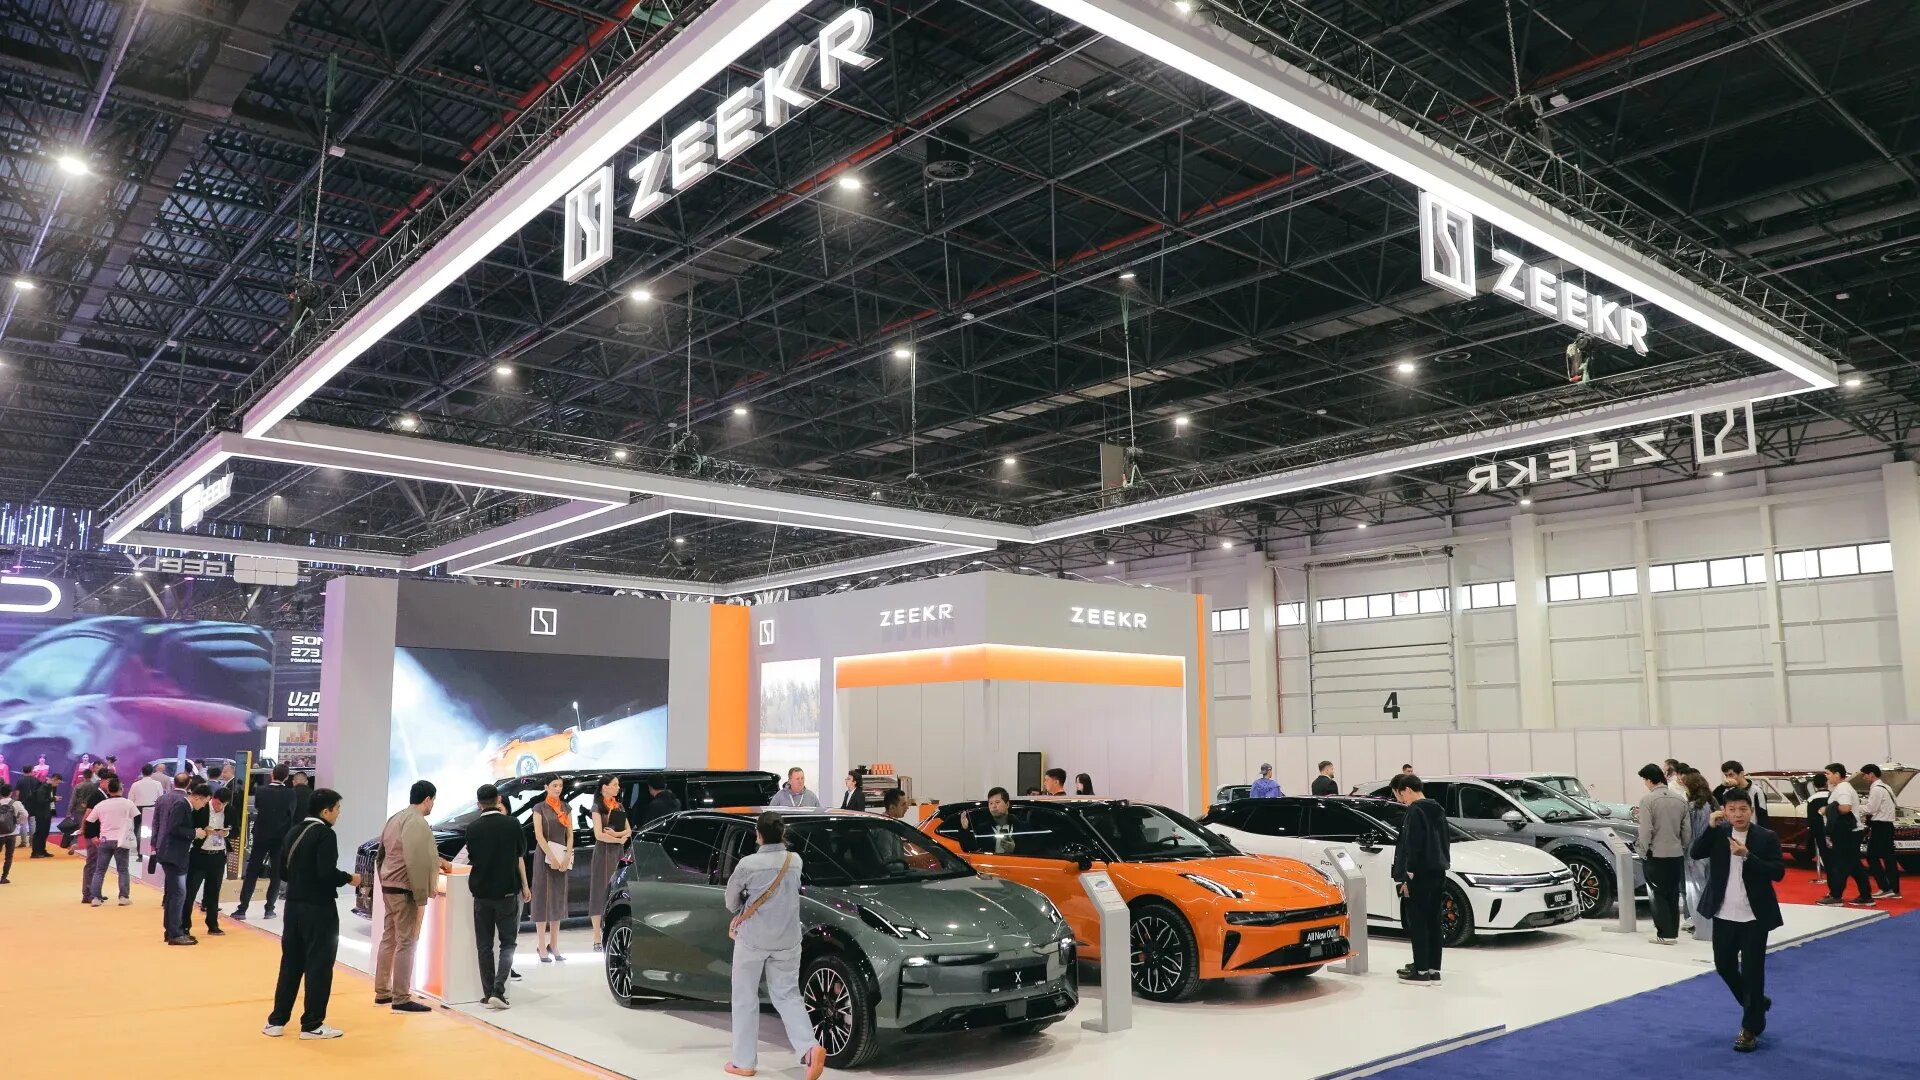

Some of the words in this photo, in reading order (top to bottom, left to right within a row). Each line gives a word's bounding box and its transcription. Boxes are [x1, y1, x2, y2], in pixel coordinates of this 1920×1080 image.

[629, 7, 880, 221] ZEEKR
[1492, 248, 1649, 355] ZEEKR
[879, 603, 953, 627] ZEEKR
[1071, 606, 1148, 629] ZEEKR
[290, 647, 320, 658] 273
[1383, 691, 1401, 719] 4
[1014, 970, 1022, 983] X
